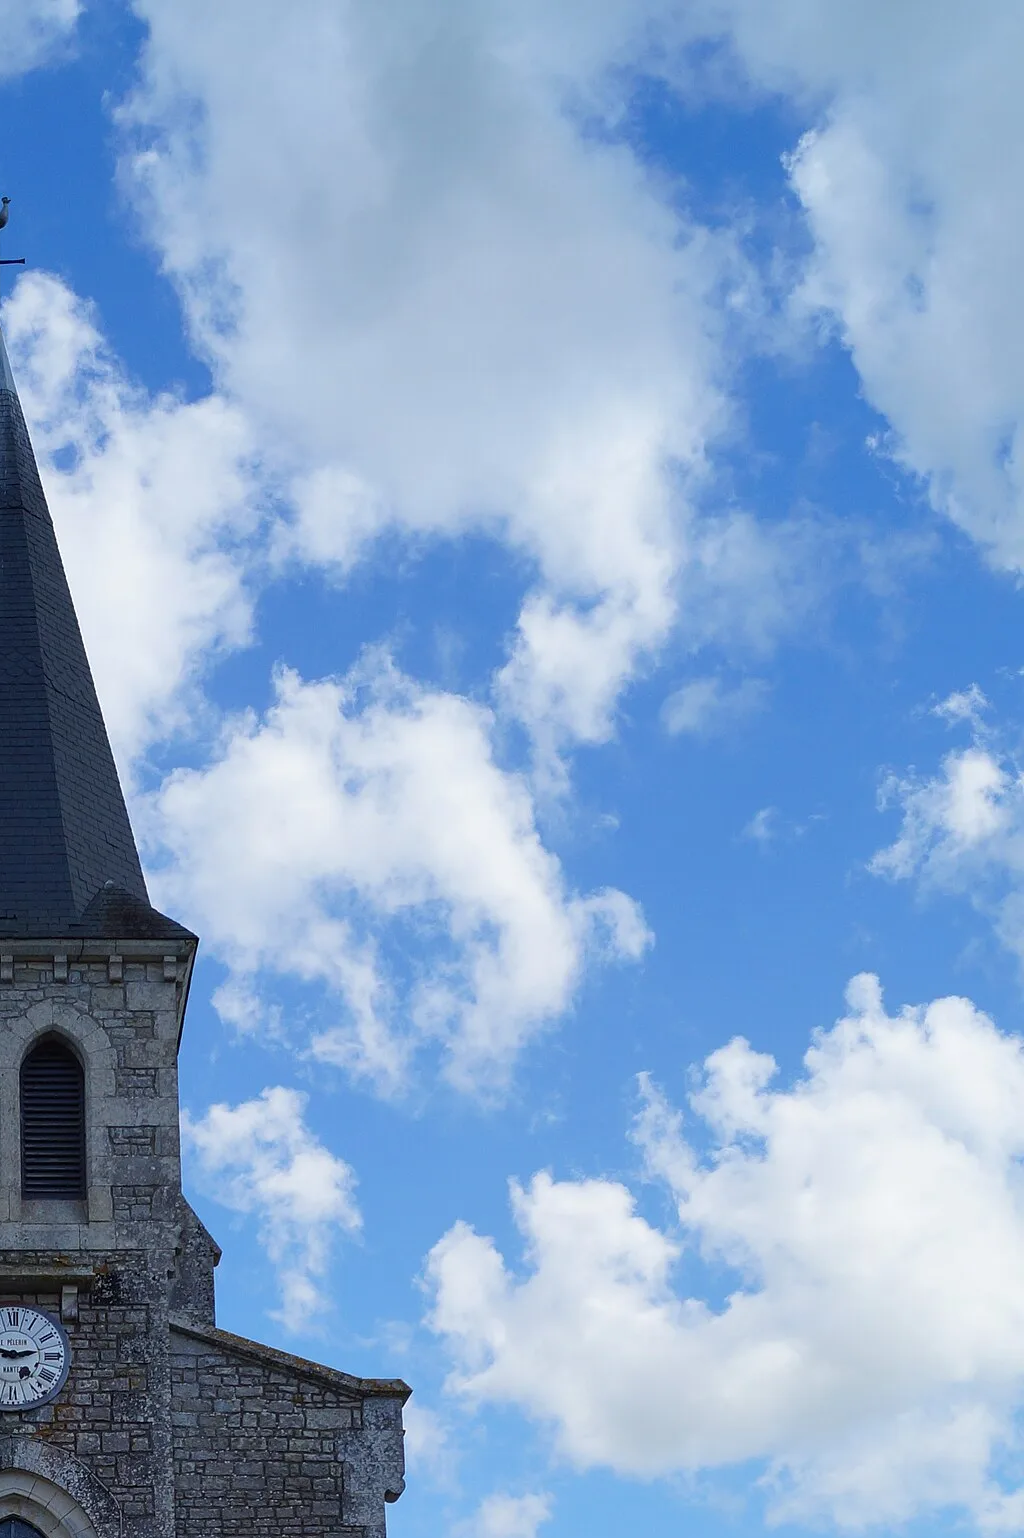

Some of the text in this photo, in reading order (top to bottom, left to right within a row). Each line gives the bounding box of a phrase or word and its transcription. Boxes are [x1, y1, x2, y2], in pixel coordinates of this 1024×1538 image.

[7, 1311, 19, 1327] XII
[28, 1317, 38, 1331] I
[39, 1332, 55, 1344] II
[44, 1352, 60, 1361] III
